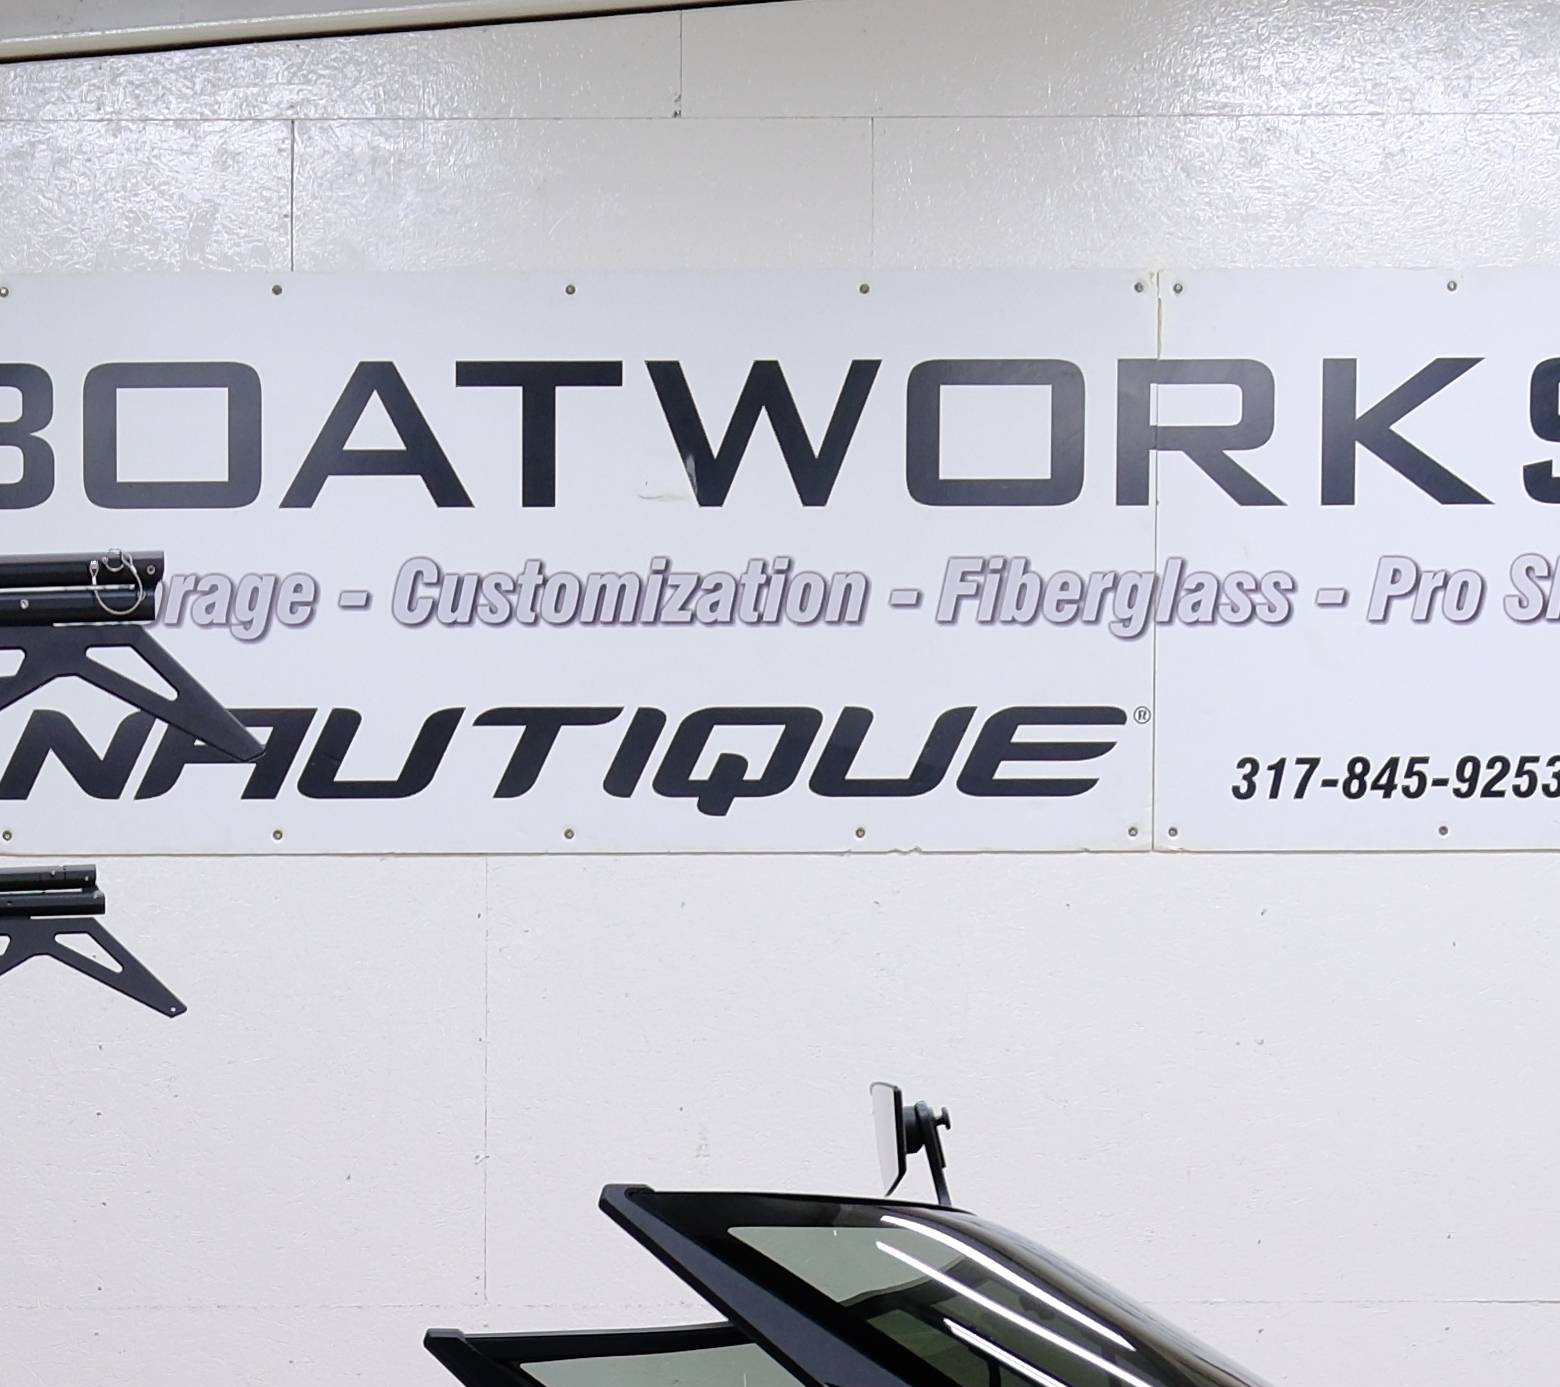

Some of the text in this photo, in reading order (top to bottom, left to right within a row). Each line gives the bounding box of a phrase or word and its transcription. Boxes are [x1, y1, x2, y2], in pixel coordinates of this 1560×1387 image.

[155, 572, 319, 643] rage
[391, 556, 871, 630] Customization
[935, 556, 1296, 641] Fiberglass
[1367, 558, 1487, 626] Pro
